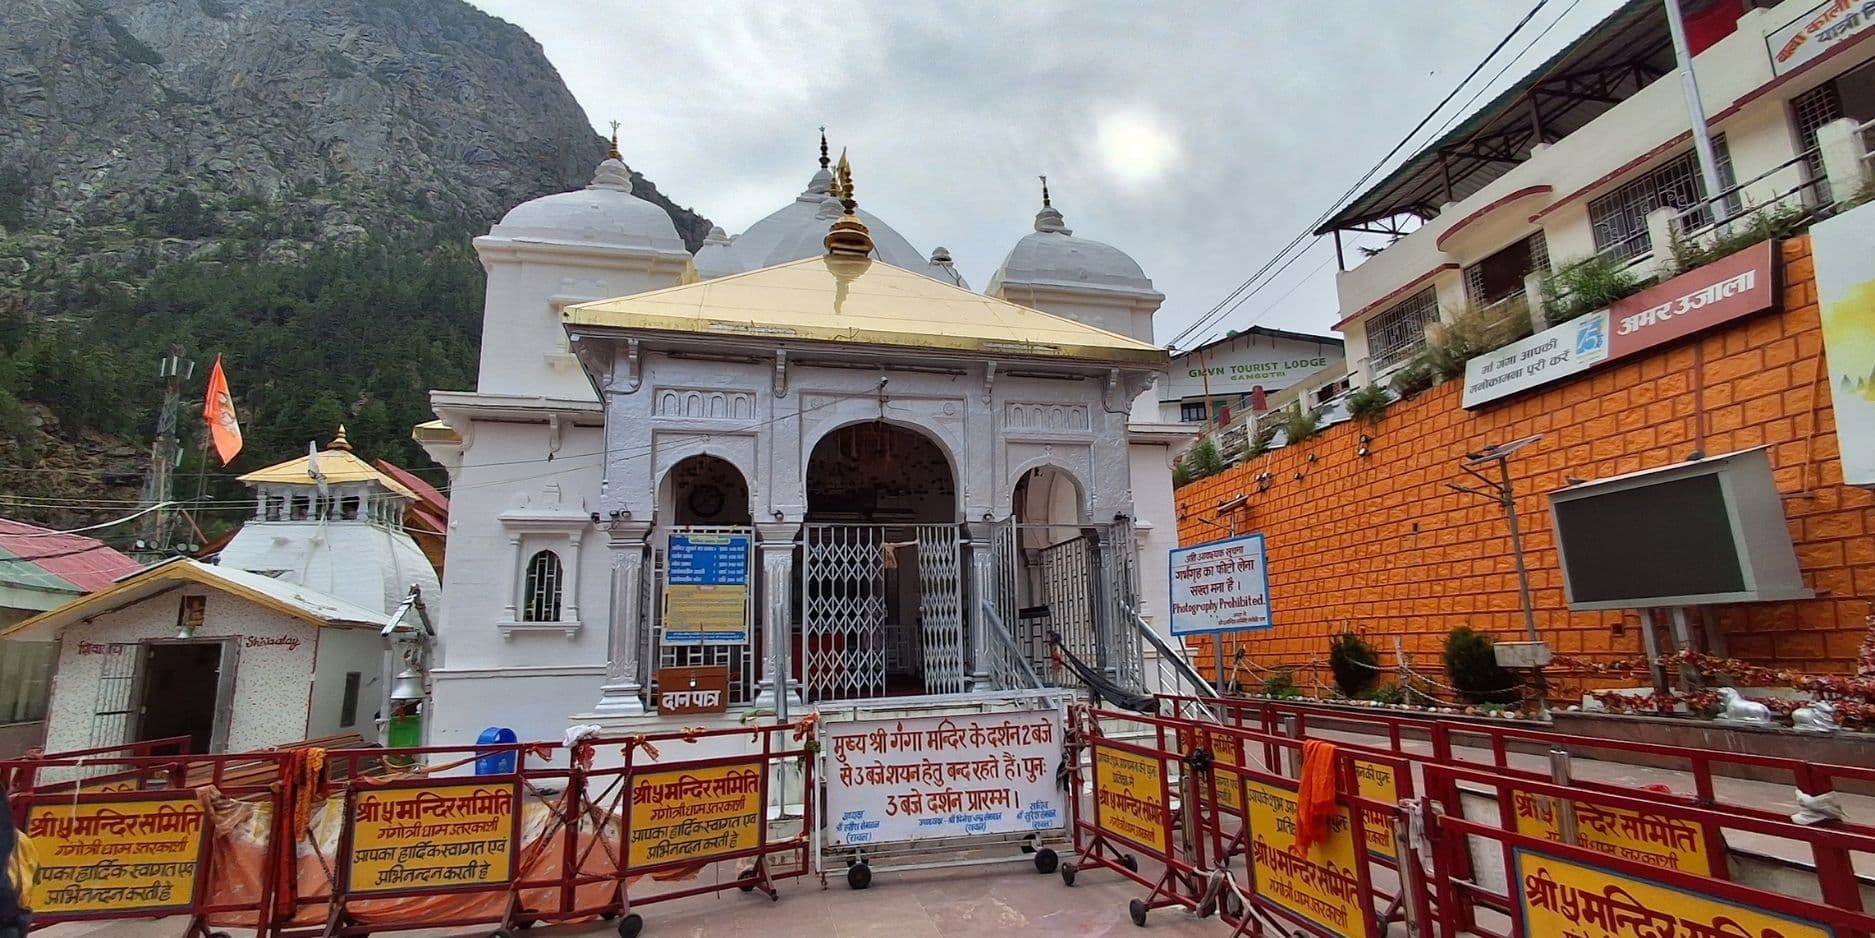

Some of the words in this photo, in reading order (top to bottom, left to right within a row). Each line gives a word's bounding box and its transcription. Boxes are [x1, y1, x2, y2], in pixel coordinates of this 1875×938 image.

[1617, 301, 1672, 337] अमर
[1673, 269, 1757, 315] उजाला
[1520, 338, 1558, 361] आपकी
[1230, 362, 1278, 374] TOURIST
[1284, 358, 1327, 370] LODGE
[1526, 359, 1548, 376] पूरी
[1225, 545, 1244, 558] सूचना
[1175, 564, 1202, 583] गर्भगृह
[1203, 566, 1214, 577] का
[1215, 560, 1236, 574] फोटो
[1210, 582, 1225, 594] मना
[1226, 577, 1234, 593] है
[1172, 600, 1218, 615] Photography
[662, 691, 691, 710] दान
[690, 689, 721, 707] पात्र
[833, 735, 867, 762] मुख्य
[870, 728, 888, 754] श्री
[890, 720, 924, 752] गंगा
[926, 718, 967, 750] मन्दिर
[968, 723, 987, 748] के
[987, 720, 1022, 748] दर्शन
[1022, 725, 1031, 745] 2
[1031, 717, 1052, 744] बजे
[839, 763, 852, 787] से
[854, 767, 864, 785] 3
[864, 762, 885, 785] बजे
[885, 764, 921, 784] शयन
[921, 758, 944, 787] हेतु
[946, 762, 970, 781] बन्द
[972, 755, 999, 780] रहते
[1024, 757, 1047, 783] पुनः
[633, 779, 653, 806] श्री
[664, 774, 713, 799] मन्दिर
[712, 769, 759, 798] समिति
[356, 796, 381, 822] श्री
[396, 791, 458, 820] मन्दिर
[457, 789, 513, 816] समिति
[685, 804, 706, 816] धाम
[885, 795, 898, 816] 3
[898, 788, 923, 816] बजे
[926, 787, 963, 812] दर्शन
[1099, 784, 1109, 806] श्री
[1116, 788, 1143, 820] मन्दिर
[28, 811, 58, 838] श्री
[74, 808, 140, 837] मन्दिर
[140, 804, 204, 835] समिति
[377, 821, 422, 839] गंगोत्री
[422, 824, 448, 838] धाम
[668, 818, 704, 840] हार्दिक
[702, 815, 742, 834] स्वागत
[101, 843, 131, 856] धाम
[398, 841, 442, 863] हार्दिक
[442, 840, 486, 858] स्वागत
[646, 840, 703, 860] अभिनन्दन
[702, 830, 729, 849] करती
[76, 859, 129, 882] हार्दिक
[375, 865, 445, 886] अभिनन्दन
[443, 860, 478, 880] करती
[1253, 833, 1268, 866] श्री
[1278, 845, 1319, 892] मन्दिर
[1316, 860, 1360, 909] समिति
[45, 884, 127, 904] अभिनन्दन
[127, 880, 159, 900] करती
[1293, 889, 1310, 908] धाम
[1525, 867, 1561, 913] श्री
[1579, 885, 1677, 938] मन्दिर
